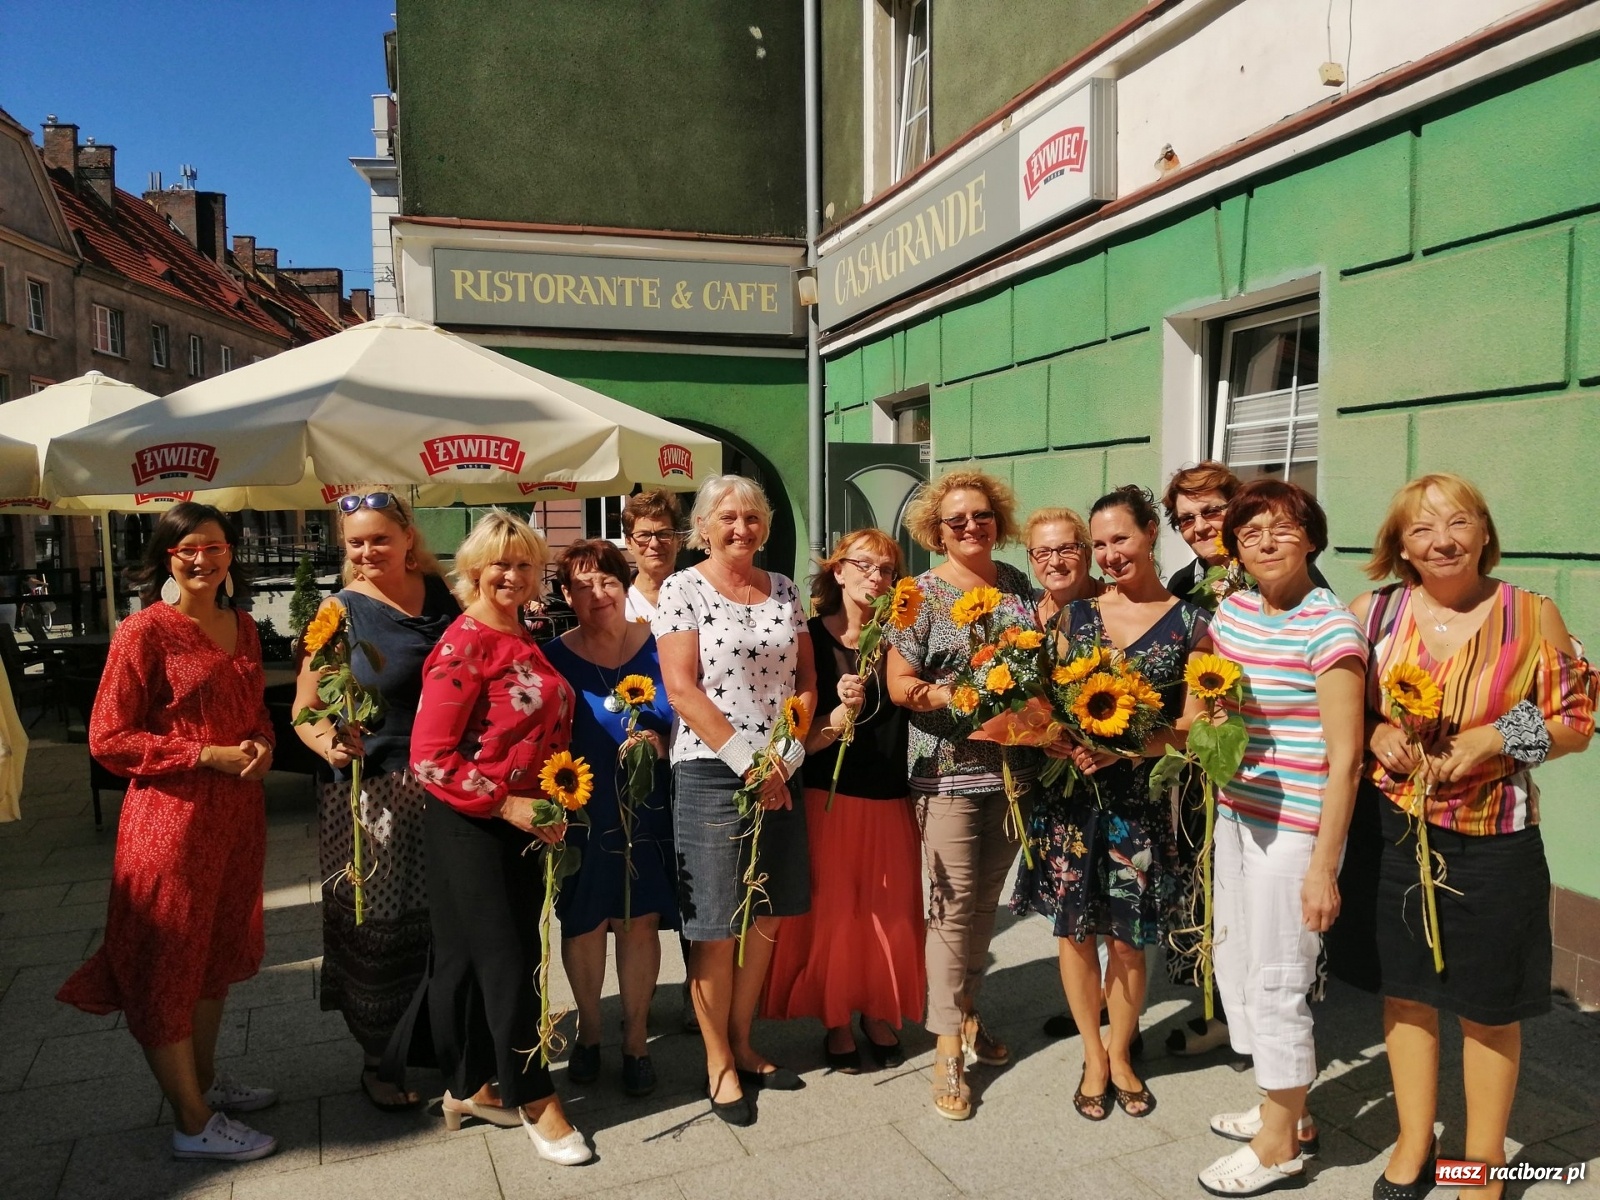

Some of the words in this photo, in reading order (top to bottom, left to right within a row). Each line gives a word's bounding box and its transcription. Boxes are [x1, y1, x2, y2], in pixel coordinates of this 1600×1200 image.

[1030, 132, 1080, 182] ŻYWIEC
[834, 169, 986, 306] CASAGRANDE
[450, 269, 661, 309] RISTORANTE
[671, 280, 694, 310] &
[702, 279, 778, 313] CAFE
[142, 449, 209, 473] ŻYWIEC
[433, 438, 513, 462] ŻYWIEC
[662, 446, 690, 469] ŻYWIEC
